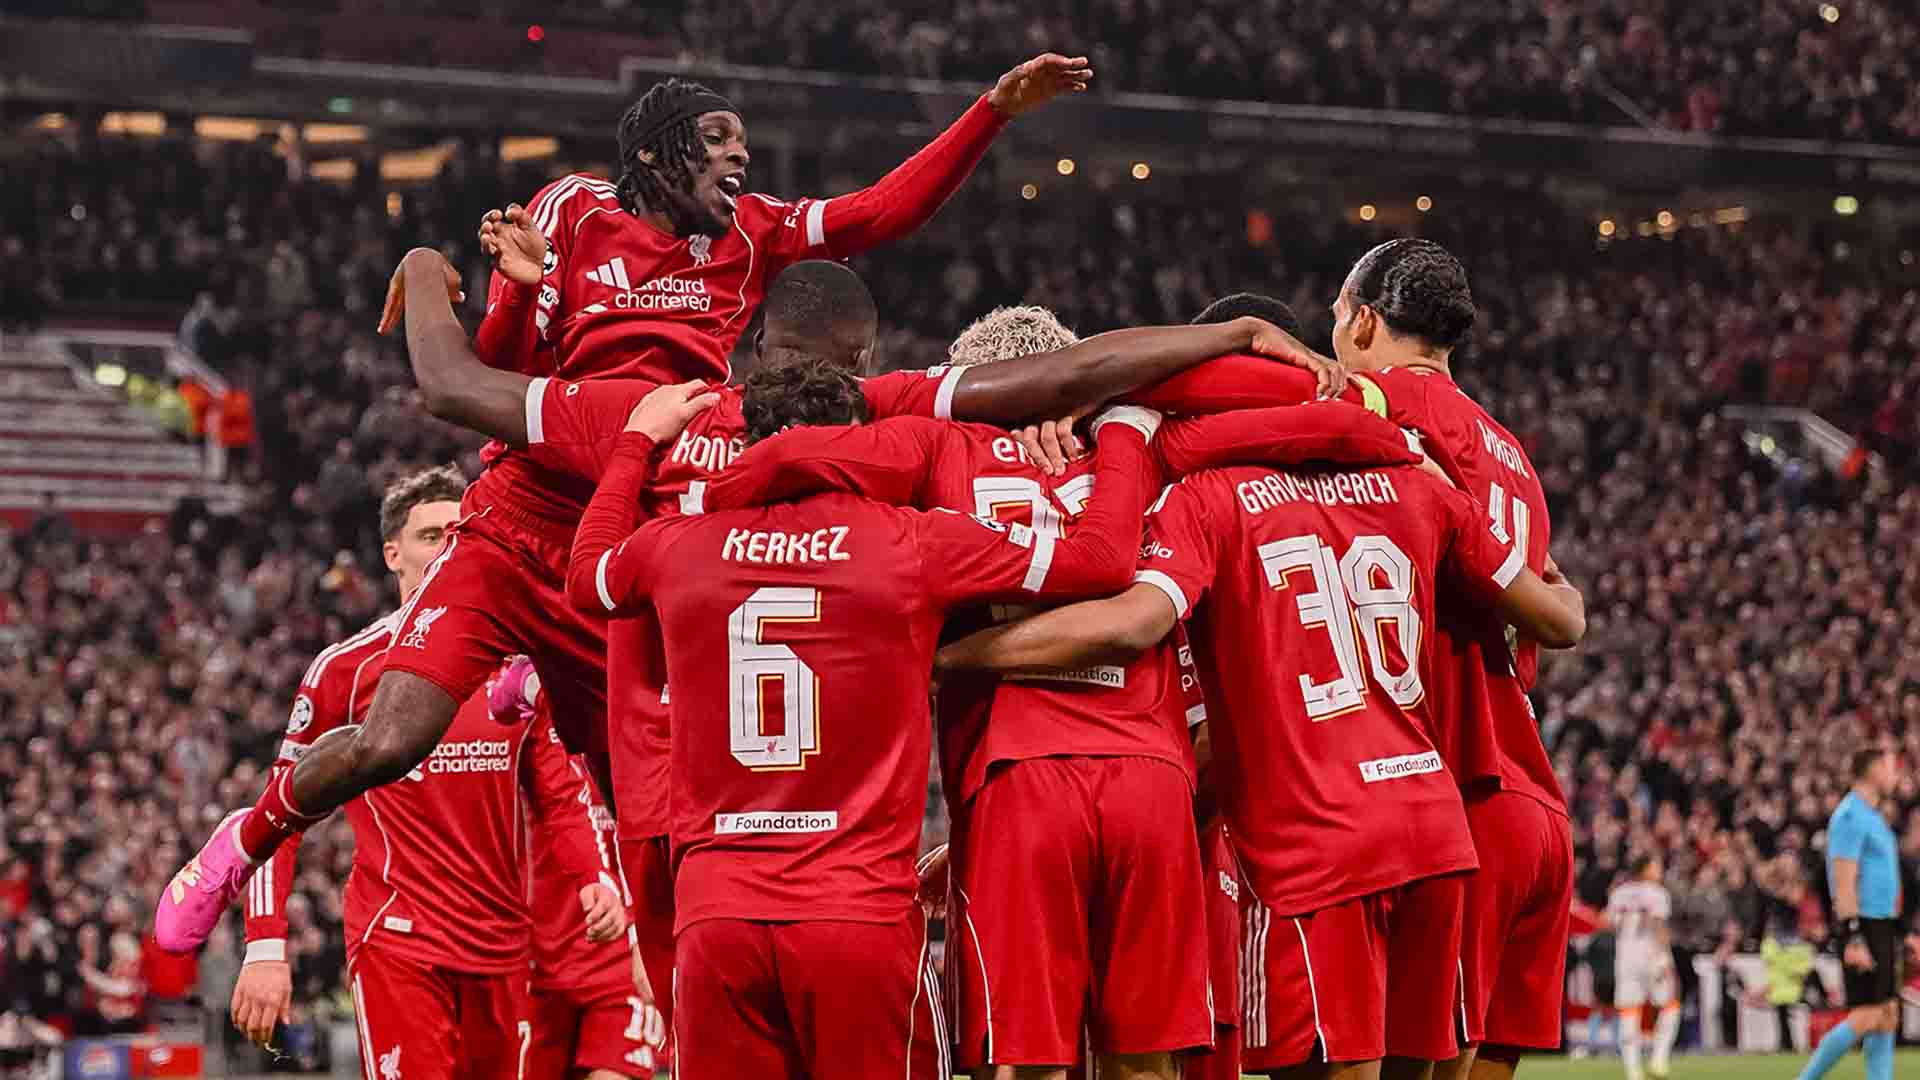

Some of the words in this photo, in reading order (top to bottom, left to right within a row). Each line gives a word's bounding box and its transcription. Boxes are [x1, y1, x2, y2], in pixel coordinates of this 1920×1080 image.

[615, 291, 711, 312] chartered
[722, 526, 850, 564] KERKEZ
[1257, 533, 1426, 722] 38
[728, 587, 822, 772] 6
[428, 756, 511, 773] chartered
[1376, 757, 1439, 775] Foundation
[735, 815, 832, 830] Foundation
